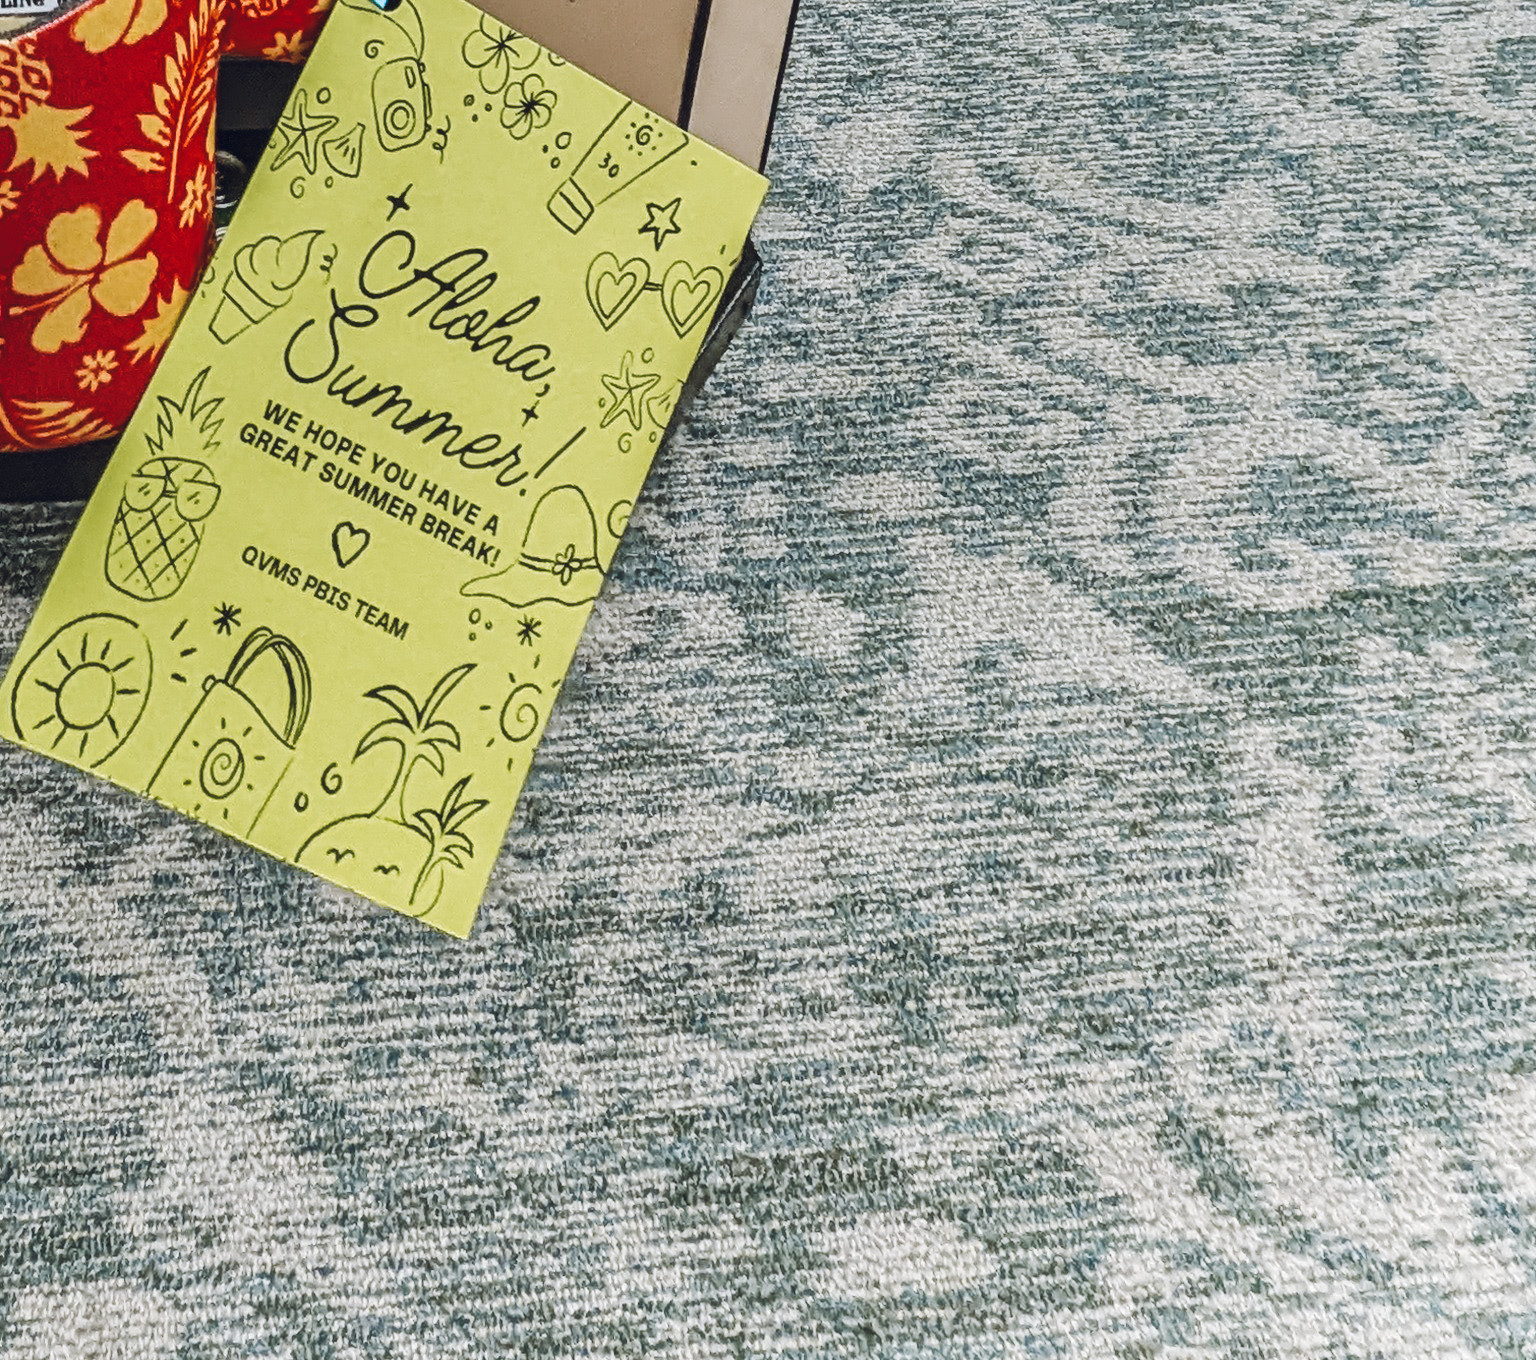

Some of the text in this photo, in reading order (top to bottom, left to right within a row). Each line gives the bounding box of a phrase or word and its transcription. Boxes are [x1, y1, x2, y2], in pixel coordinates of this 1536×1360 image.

[359, 230, 556, 398] Aloha,
[284, 288, 586, 497] Summer!
[239, 423, 501, 568] GREAT SUMMER BREAK!
[263, 399, 499, 537] WE HOPE YOU HAVE A
[241, 546, 410, 641] QVMS PBIS TEAM
